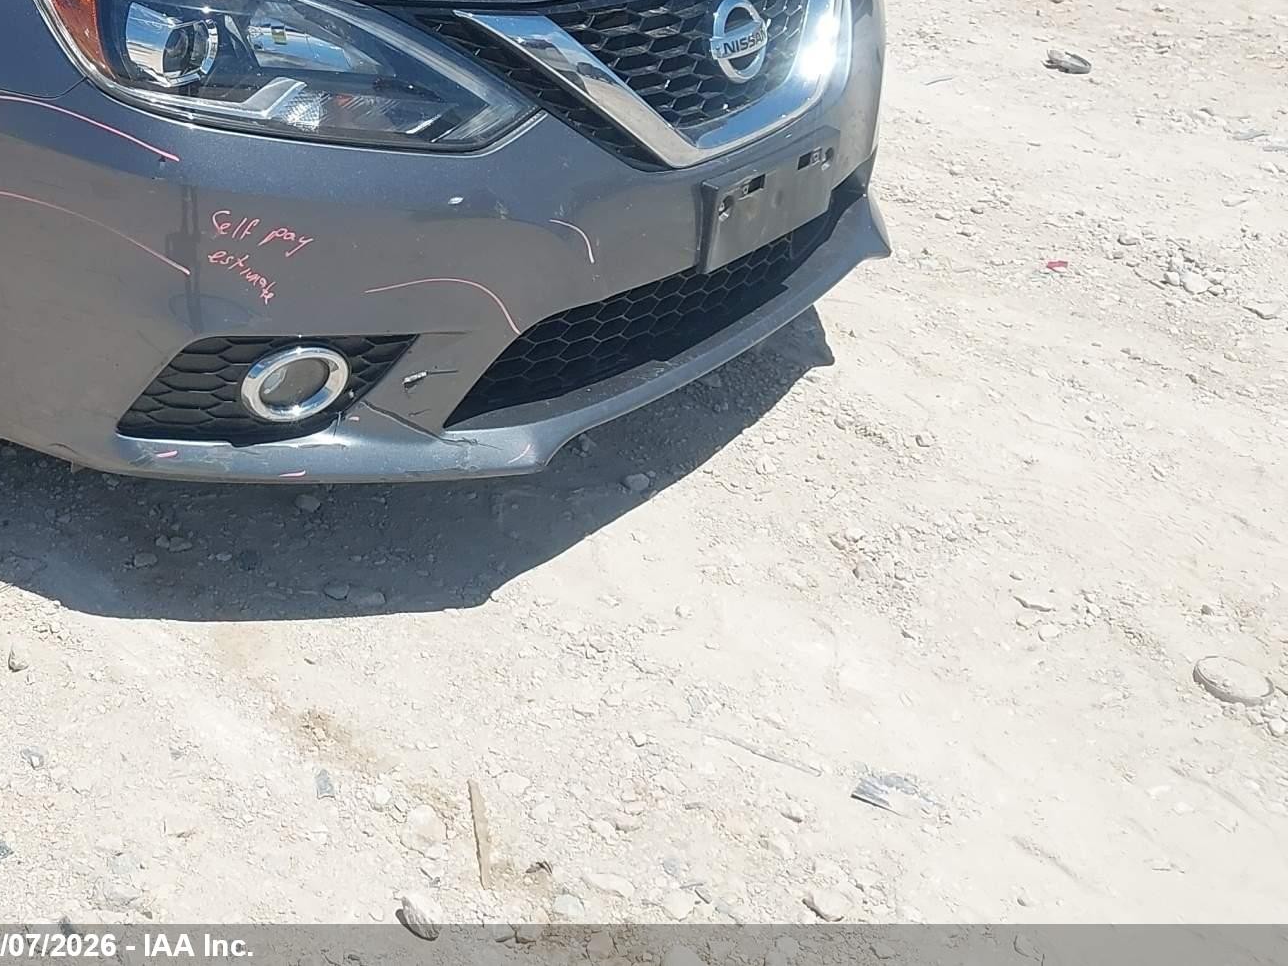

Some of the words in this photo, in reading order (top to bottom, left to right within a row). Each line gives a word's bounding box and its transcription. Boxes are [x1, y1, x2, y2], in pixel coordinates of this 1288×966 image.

[722, 29, 767, 55] NISSAN
[212, 210, 260, 240] Self
[258, 227, 314, 257] pay
